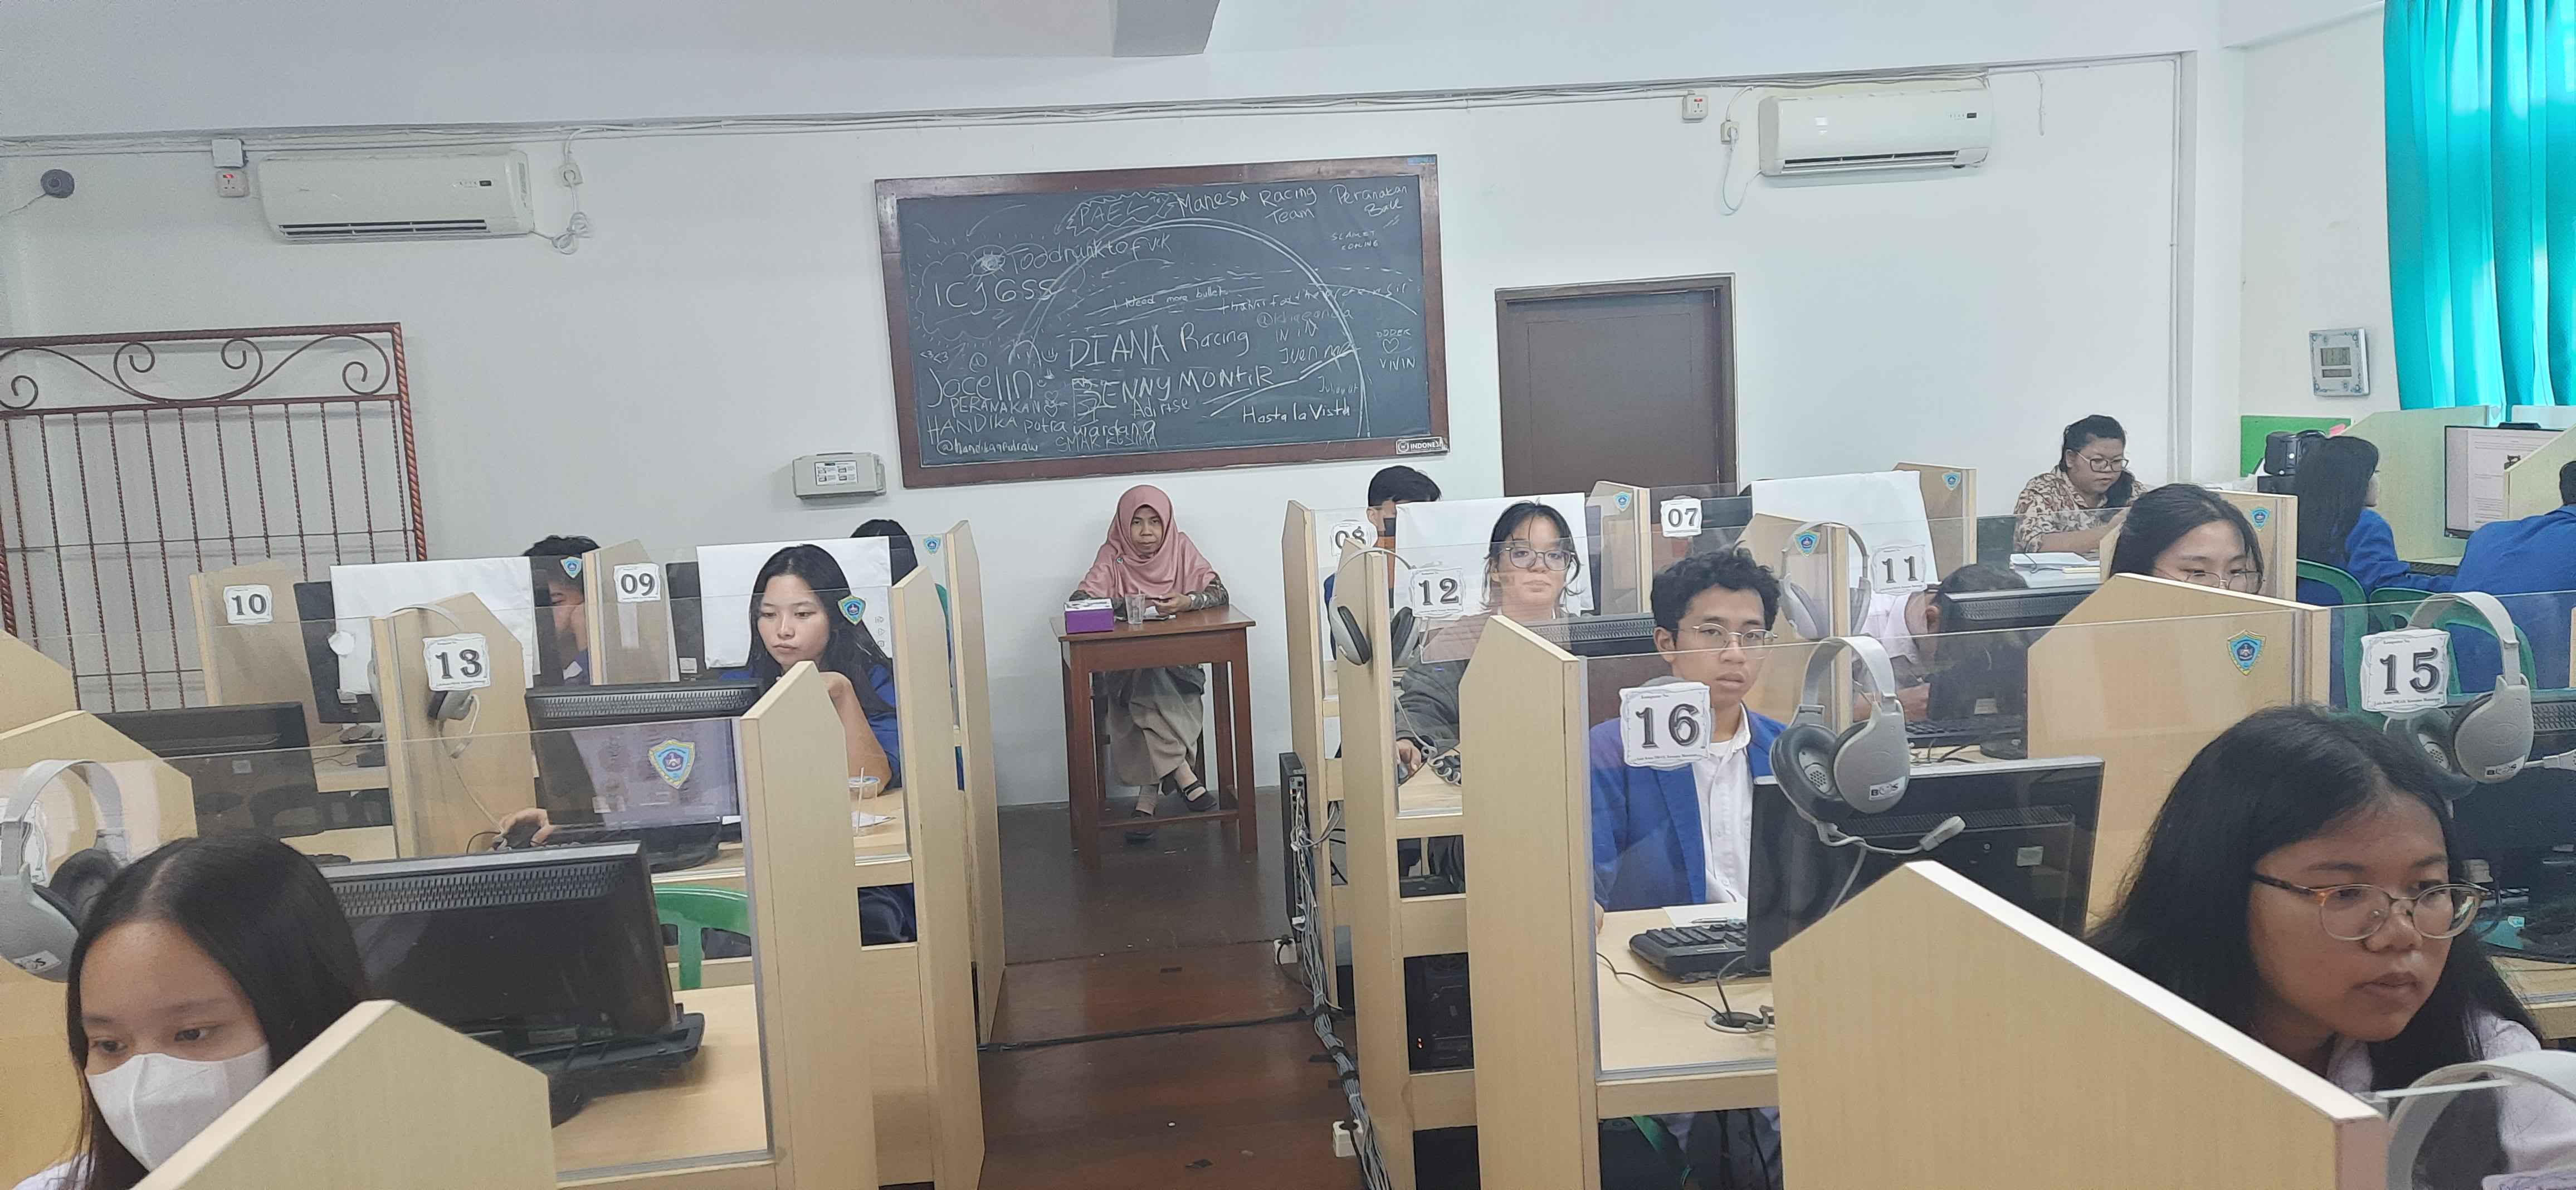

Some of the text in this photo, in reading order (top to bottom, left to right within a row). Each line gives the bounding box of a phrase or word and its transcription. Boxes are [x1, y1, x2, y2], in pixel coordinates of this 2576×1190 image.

[1258, 186, 1317, 207] Racing
[1265, 207, 1315, 225] Team
[1068, 321, 1250, 370] DIANA Racing
[950, 396, 1041, 418] PERANAKAN
[1243, 404, 1287, 423] Hasta
[1293, 402, 1307, 421] la
[926, 413, 1018, 445] HANDIKA
[1668, 508, 1699, 527] 07
[1881, 555, 1919, 583] 11
[621, 572, 655, 596] 09
[1418, 578, 1459, 606] 12
[231, 593, 267, 616] 10
[435, 648, 482, 679] 13
[2379, 647, 2440, 695] 15
[1635, 703, 1700, 749] 16
